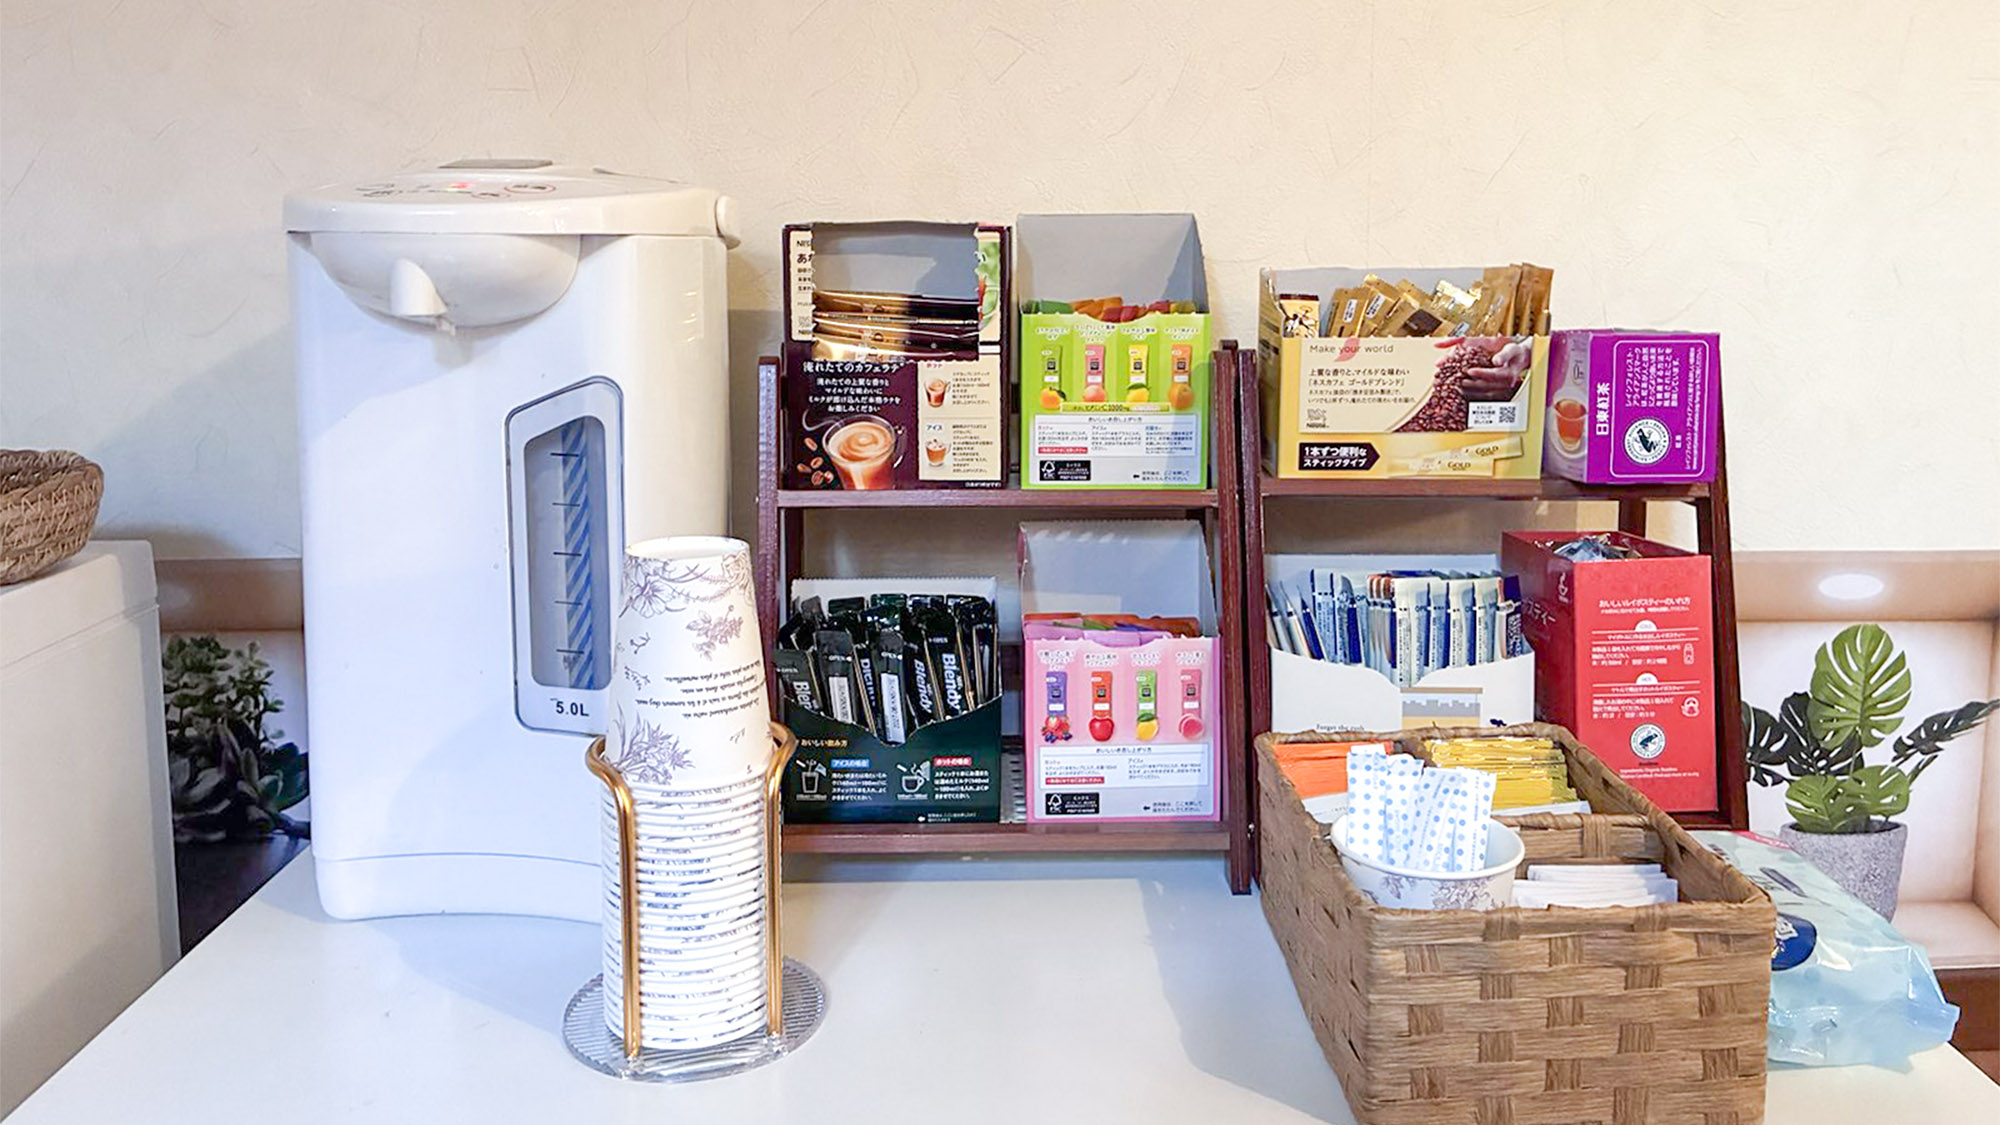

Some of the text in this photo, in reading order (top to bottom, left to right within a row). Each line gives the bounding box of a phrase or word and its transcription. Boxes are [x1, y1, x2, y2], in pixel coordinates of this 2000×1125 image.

[1309, 345, 1394, 355] Make your world
[1595, 382, 1610, 436] 日東紅茶
[1304, 446, 1367, 457] 1本ずつ便利な
[1303, 458, 1367, 467] スティックタイプ
[914, 659, 933, 713] Blendy
[942, 653, 961, 710] Blendy
[556, 701, 590, 717] 5.0L
